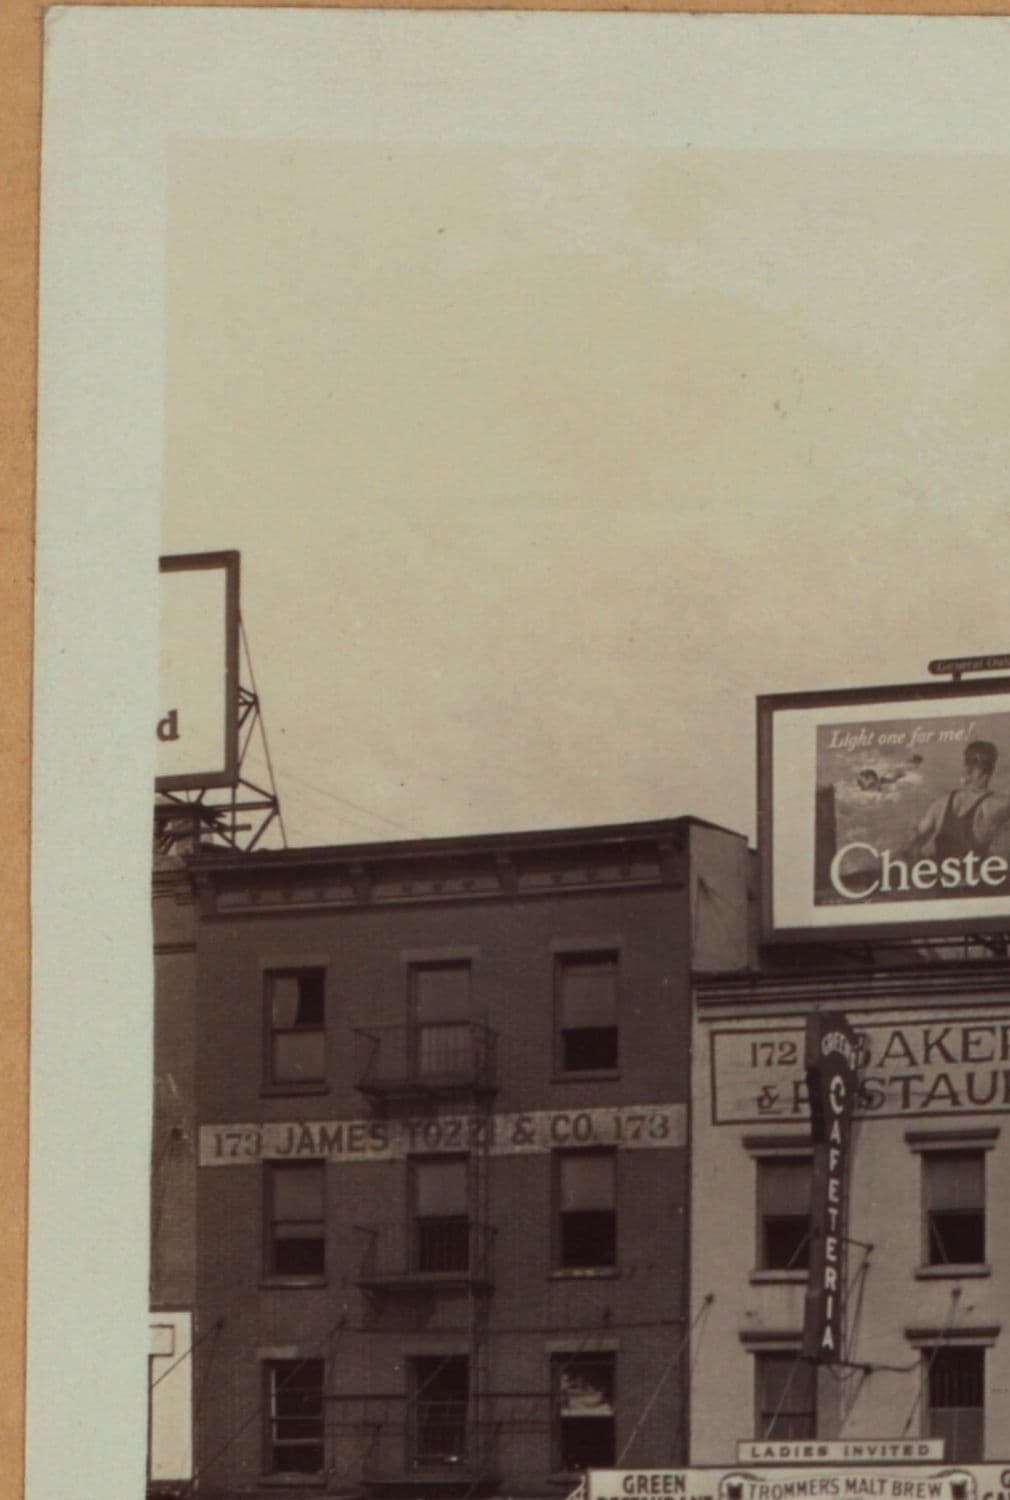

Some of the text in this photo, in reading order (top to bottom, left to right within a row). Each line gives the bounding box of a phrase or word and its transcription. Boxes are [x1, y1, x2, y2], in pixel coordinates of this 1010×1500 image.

[827, 721, 976, 752] Light one for me!
[750, 1040, 798, 1069] 172
[214, 1131, 263, 1159] 173
[275, 1122, 390, 1157] JAMES
[511, 1114, 536, 1146] &
[612, 1111, 671, 1142] 173
[821, 1074, 846, 1350] CAFETERIA
[750, 1443, 931, 1459] LADIES INVITED
[622, 1474, 687, 1496] GREEN
[843, 1477, 888, 1497] MALT
[891, 1479, 943, 1499] BREW
